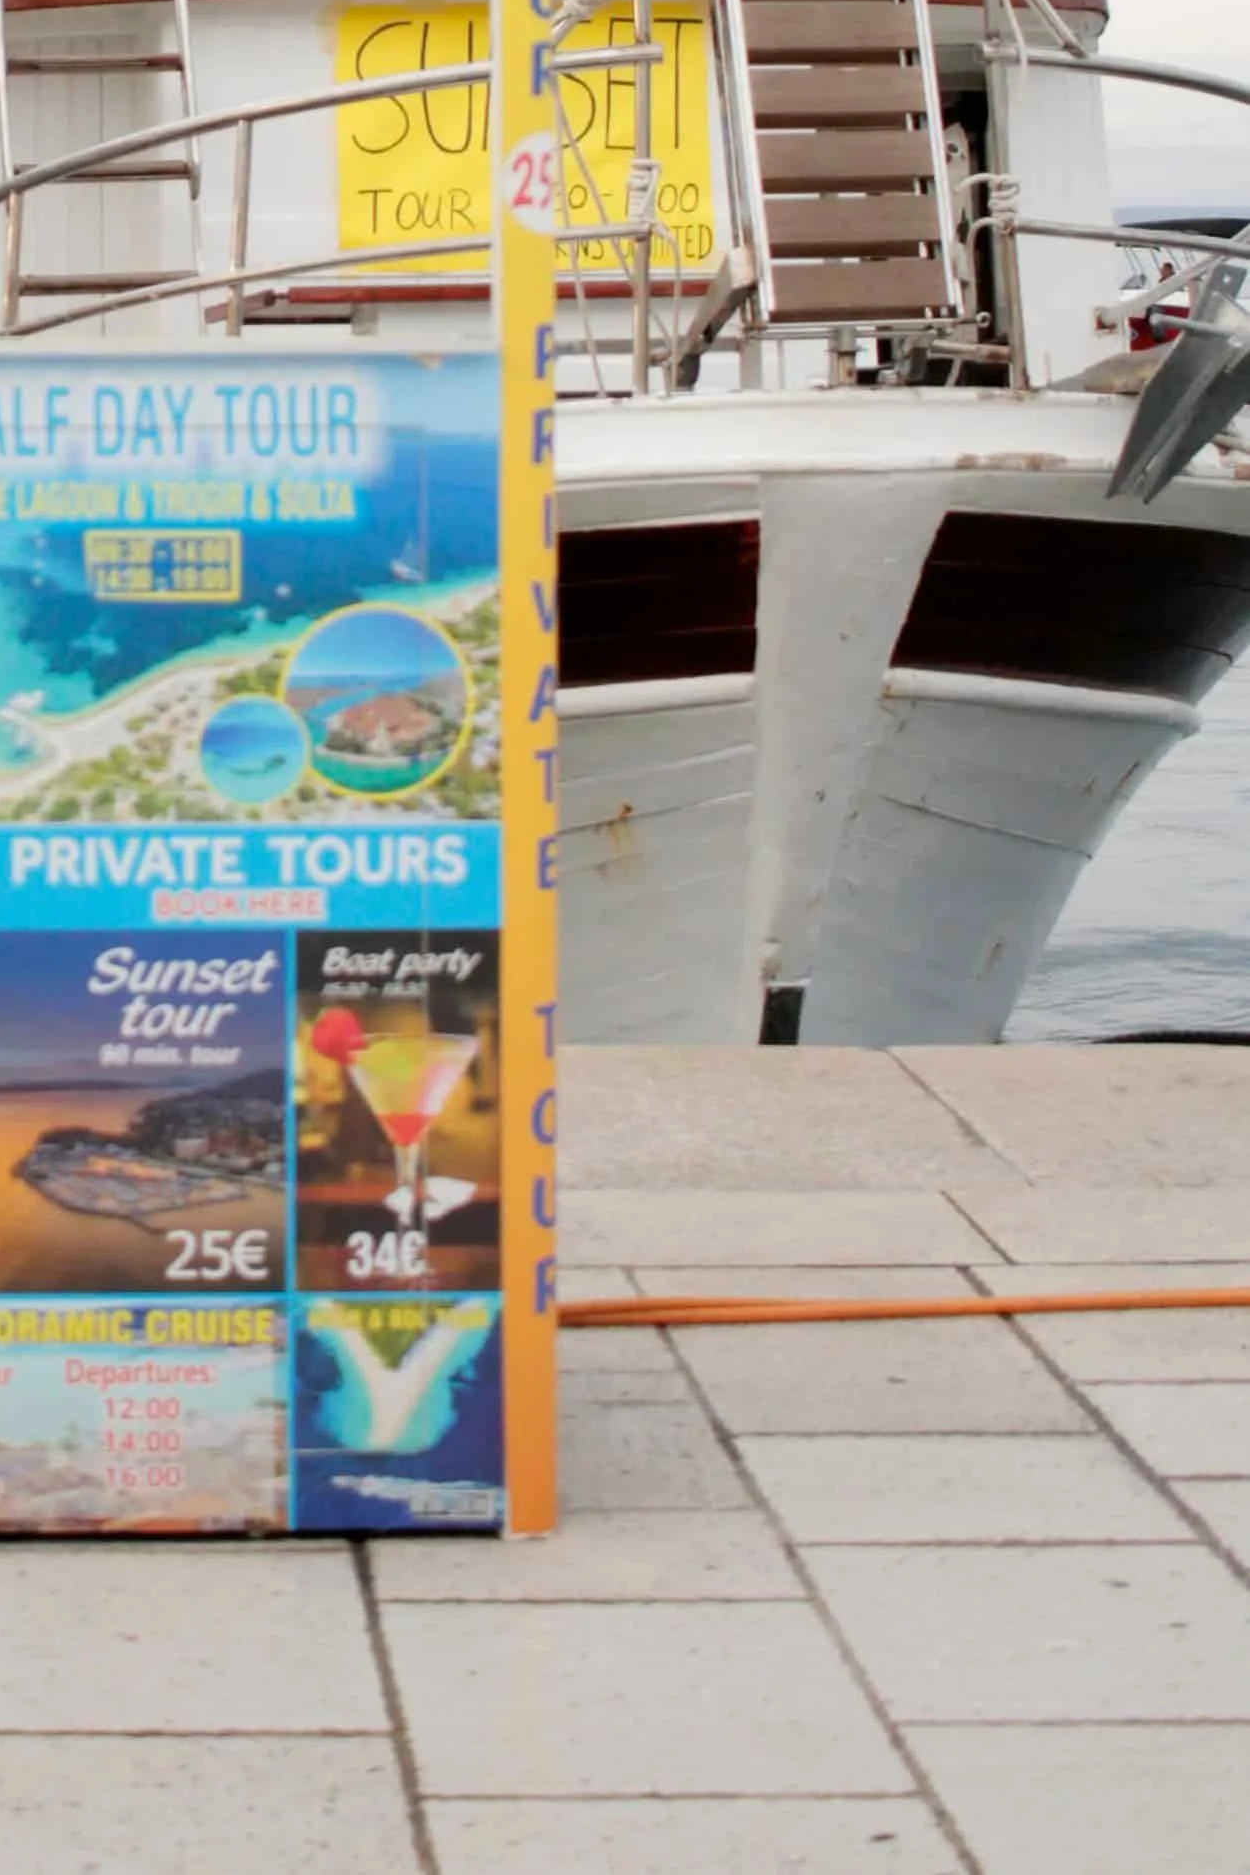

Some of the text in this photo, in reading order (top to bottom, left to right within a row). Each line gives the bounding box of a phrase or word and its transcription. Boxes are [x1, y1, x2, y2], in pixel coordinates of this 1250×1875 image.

[357, 188, 476, 234] TOUR
[94, 385, 193, 456] DAY
[216, 385, 360, 456] TOUR
[10, 834, 468, 886] PRIVATE TOURS
[154, 891, 324, 917] BOOK HERE
[87, 945, 280, 996] Sunset
[322, 946, 484, 982] Boat party
[119, 993, 238, 1039] tour
[189, 1044, 245, 1066] tour
[164, 1229, 271, 1281] 25€
[346, 1229, 430, 1279] 34€
[145, 1308, 276, 1343] CRUISE
[64, 1358, 219, 1389] Departures:
[104, 1397, 181, 1420] 12:00
[104, 1429, 181, 1452] 14:00
[104, 1466, 181, 1489] 16:00
